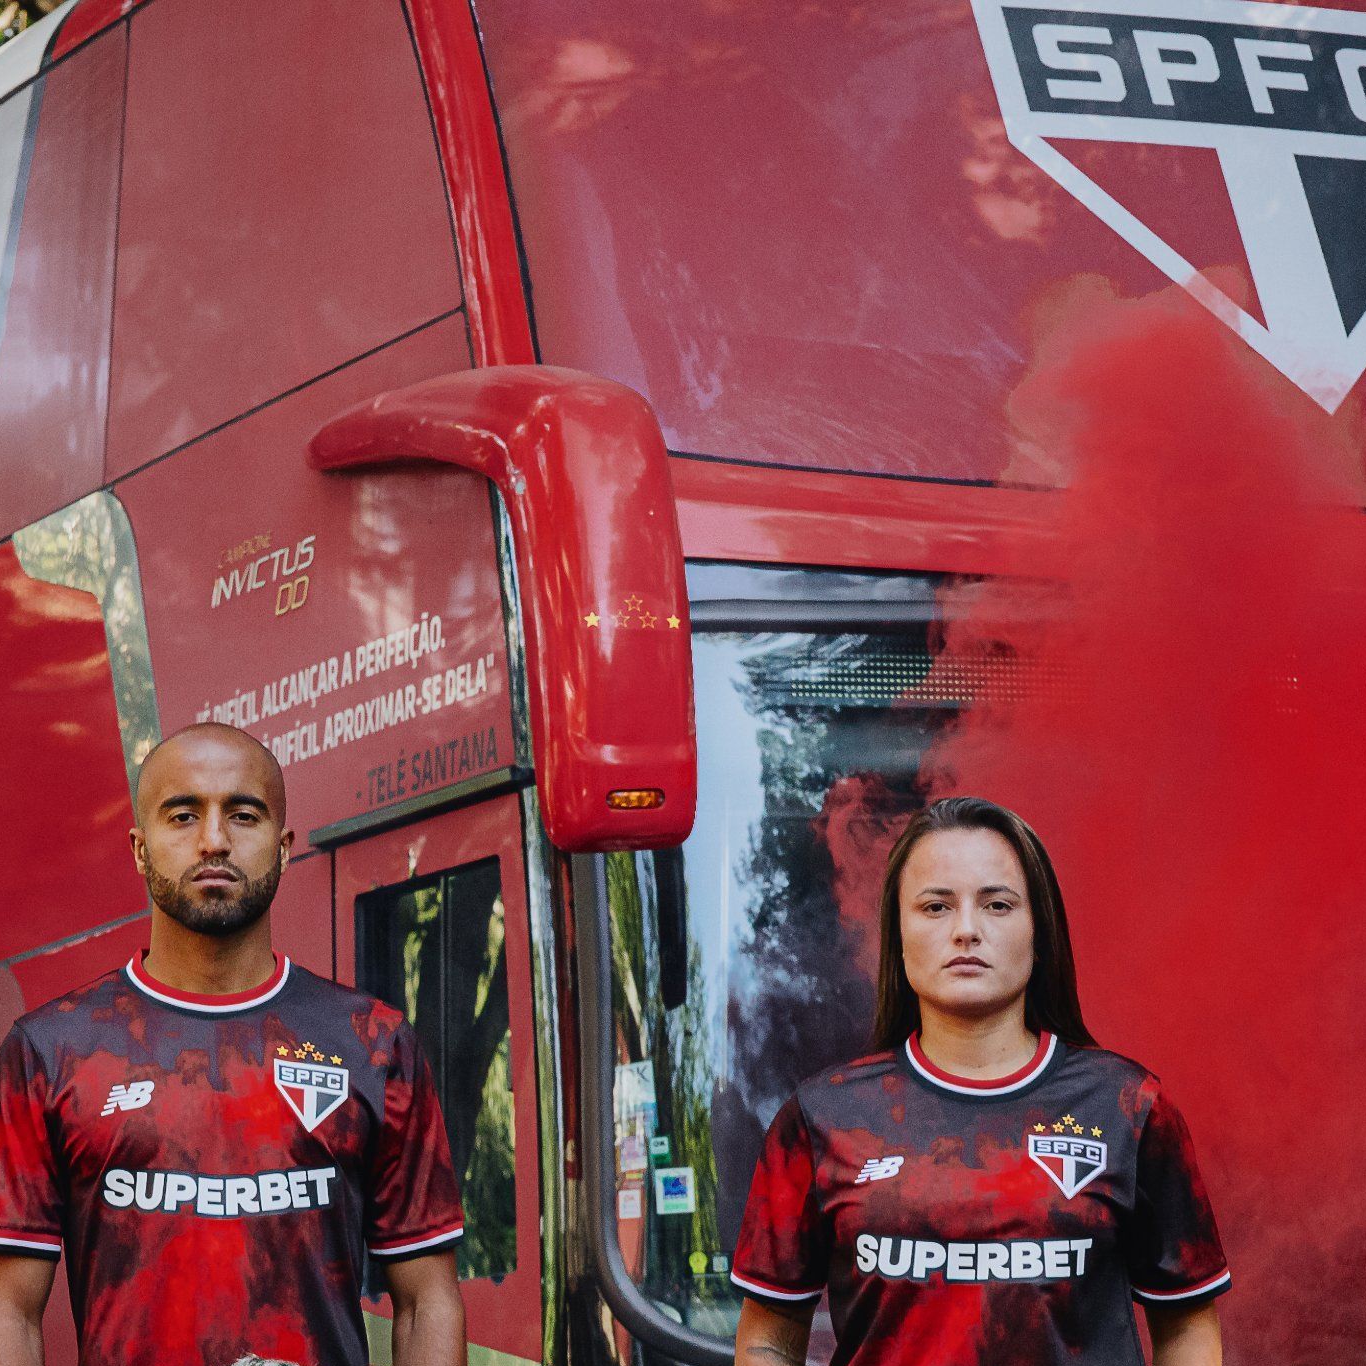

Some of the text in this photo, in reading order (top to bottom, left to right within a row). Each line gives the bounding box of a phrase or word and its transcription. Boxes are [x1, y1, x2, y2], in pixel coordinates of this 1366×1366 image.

[211, 534, 316, 609] INVICTUS
[261, 655, 339, 720] ALCANÇAR
[341, 650, 354, 688] A
[323, 673, 443, 752] APROXIMAR-SE
[367, 749, 407, 806] TELÉ
[411, 727, 498, 792] SANTANA
[280, 1066, 342, 1090] SPFC
[1035, 1139, 1101, 1161] SPFC
[103, 1166, 336, 1217] SUPERBET
[855, 1233, 1094, 1281] SUPERBET
